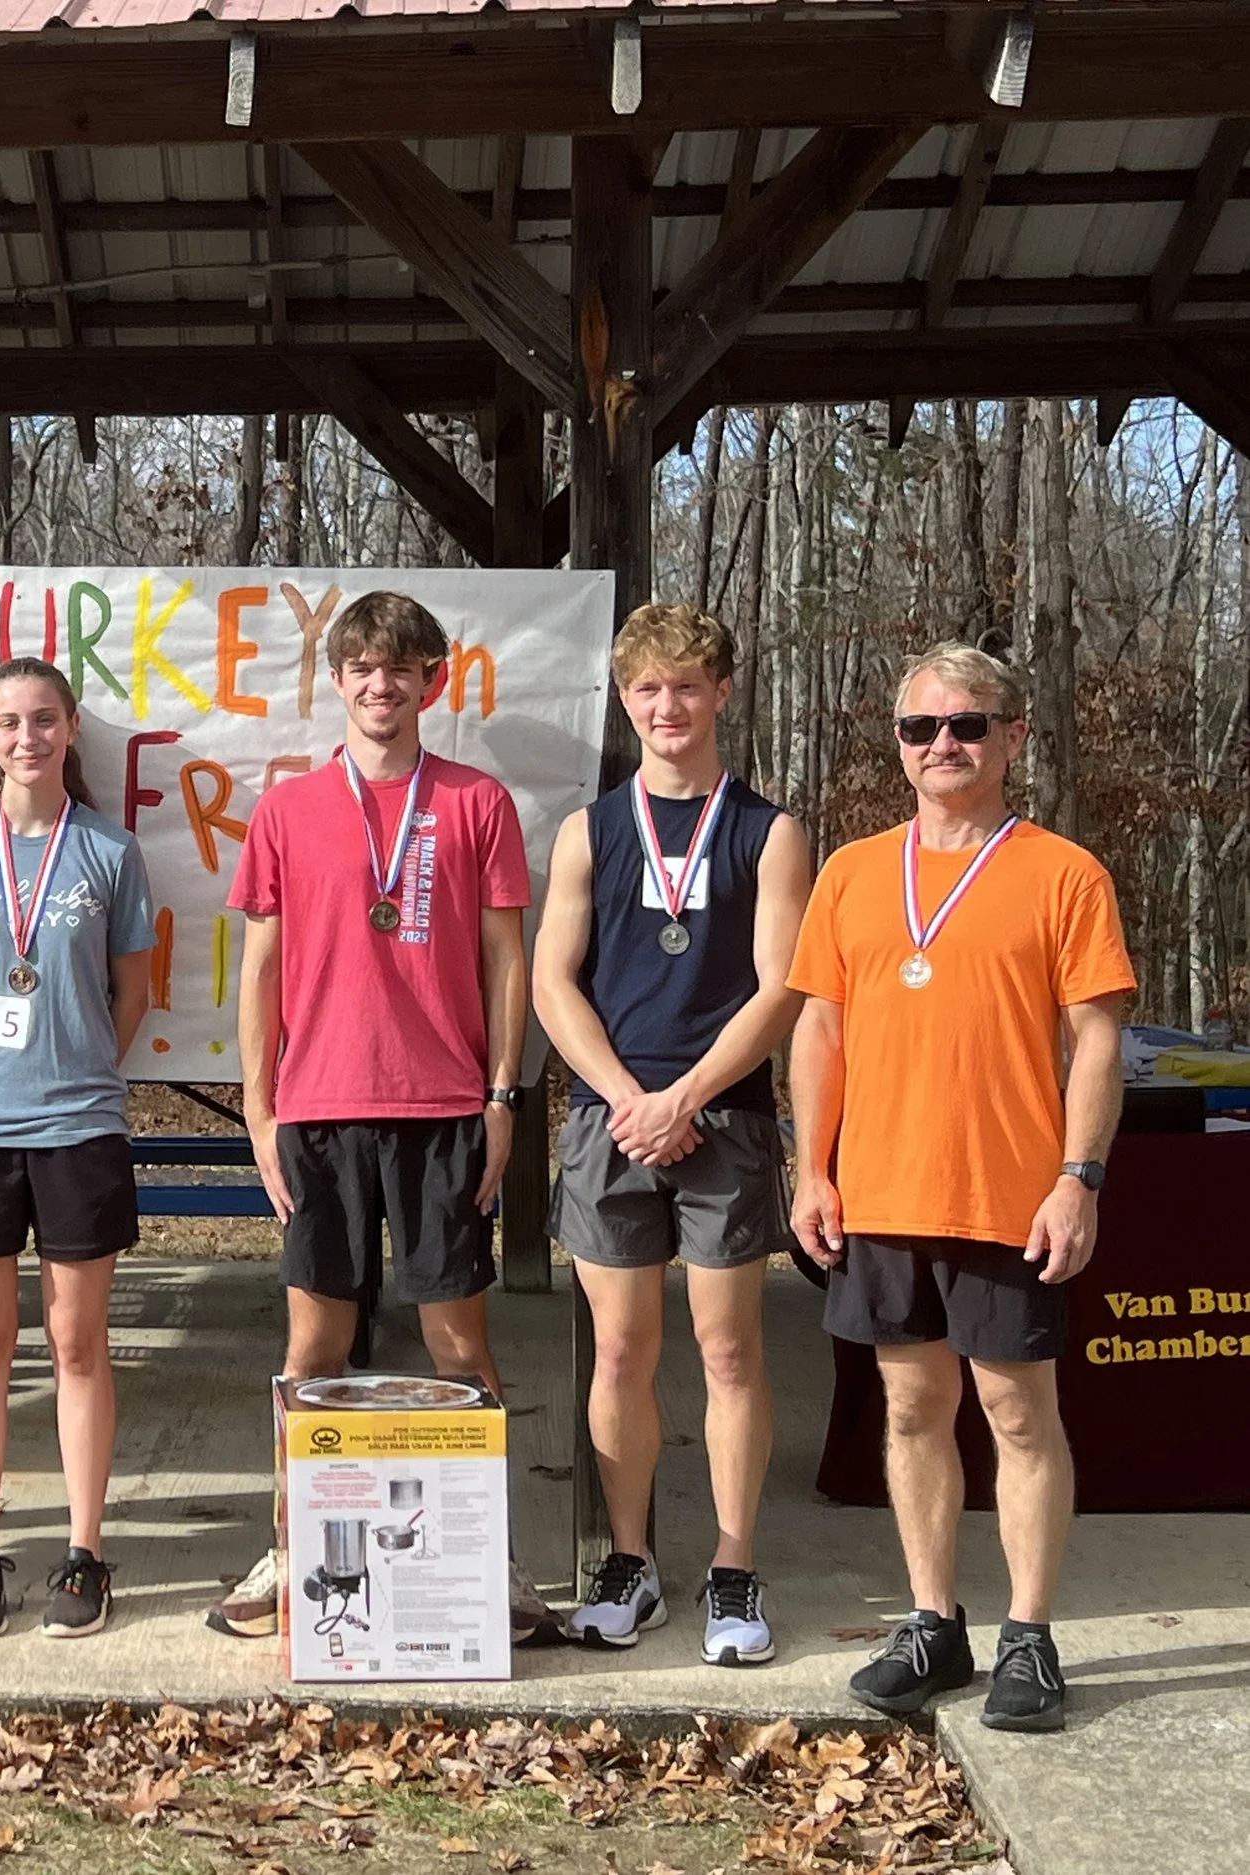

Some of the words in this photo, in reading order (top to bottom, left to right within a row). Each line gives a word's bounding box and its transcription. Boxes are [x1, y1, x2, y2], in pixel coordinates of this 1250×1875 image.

[419, 834, 437, 876] TRACK
[415, 891, 432, 928] FIELD
[1104, 1292, 1177, 1319] Van
